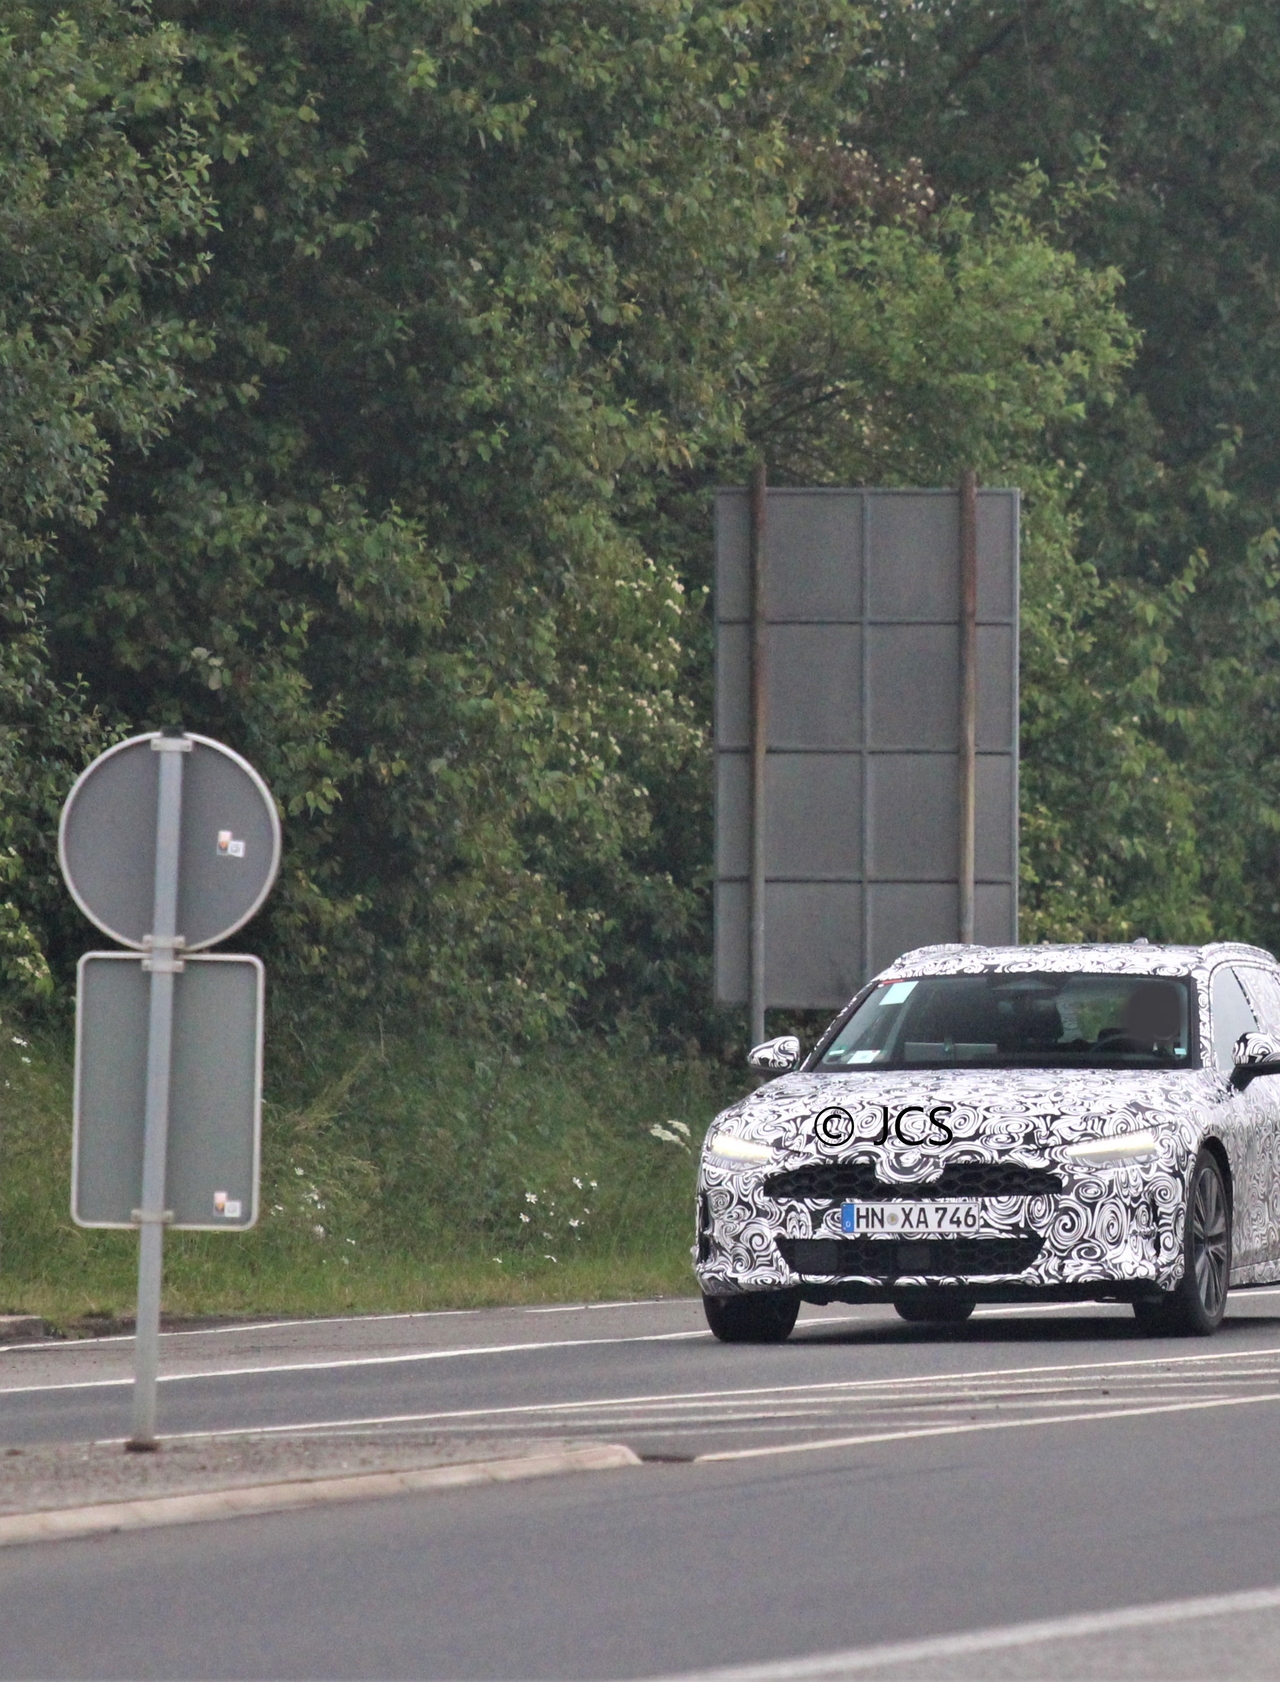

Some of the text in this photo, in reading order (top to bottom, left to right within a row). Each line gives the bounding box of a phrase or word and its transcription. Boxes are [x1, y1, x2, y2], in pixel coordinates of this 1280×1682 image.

[856, 1206, 977, 1229] HN XA 746
